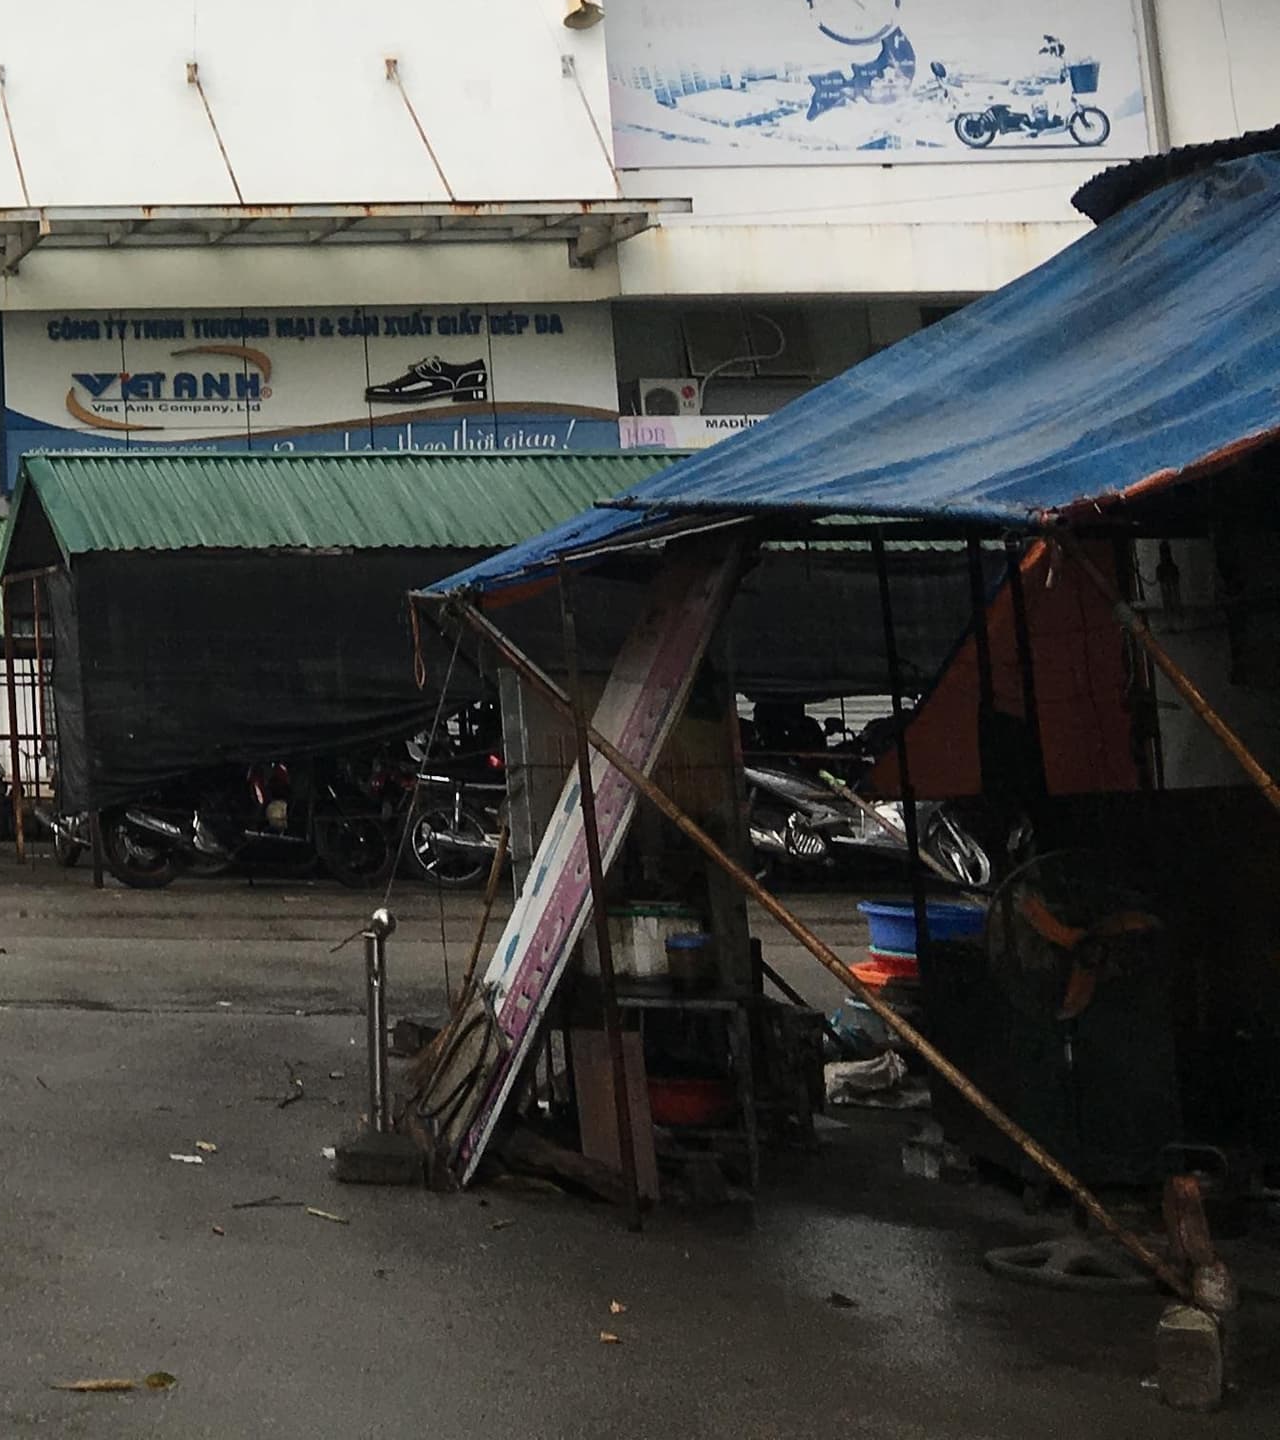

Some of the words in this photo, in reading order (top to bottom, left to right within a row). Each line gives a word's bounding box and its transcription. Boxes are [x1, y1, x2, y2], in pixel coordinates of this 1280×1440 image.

[47, 316, 100, 340] CÔNG
[131, 318, 185, 339] TNHH
[319, 317, 334, 337] &
[172, 372, 261, 401] ANH
[92, 402, 119, 413] Viet
[126, 402, 154, 412] Anh
[158, 401, 235, 416] Company,
